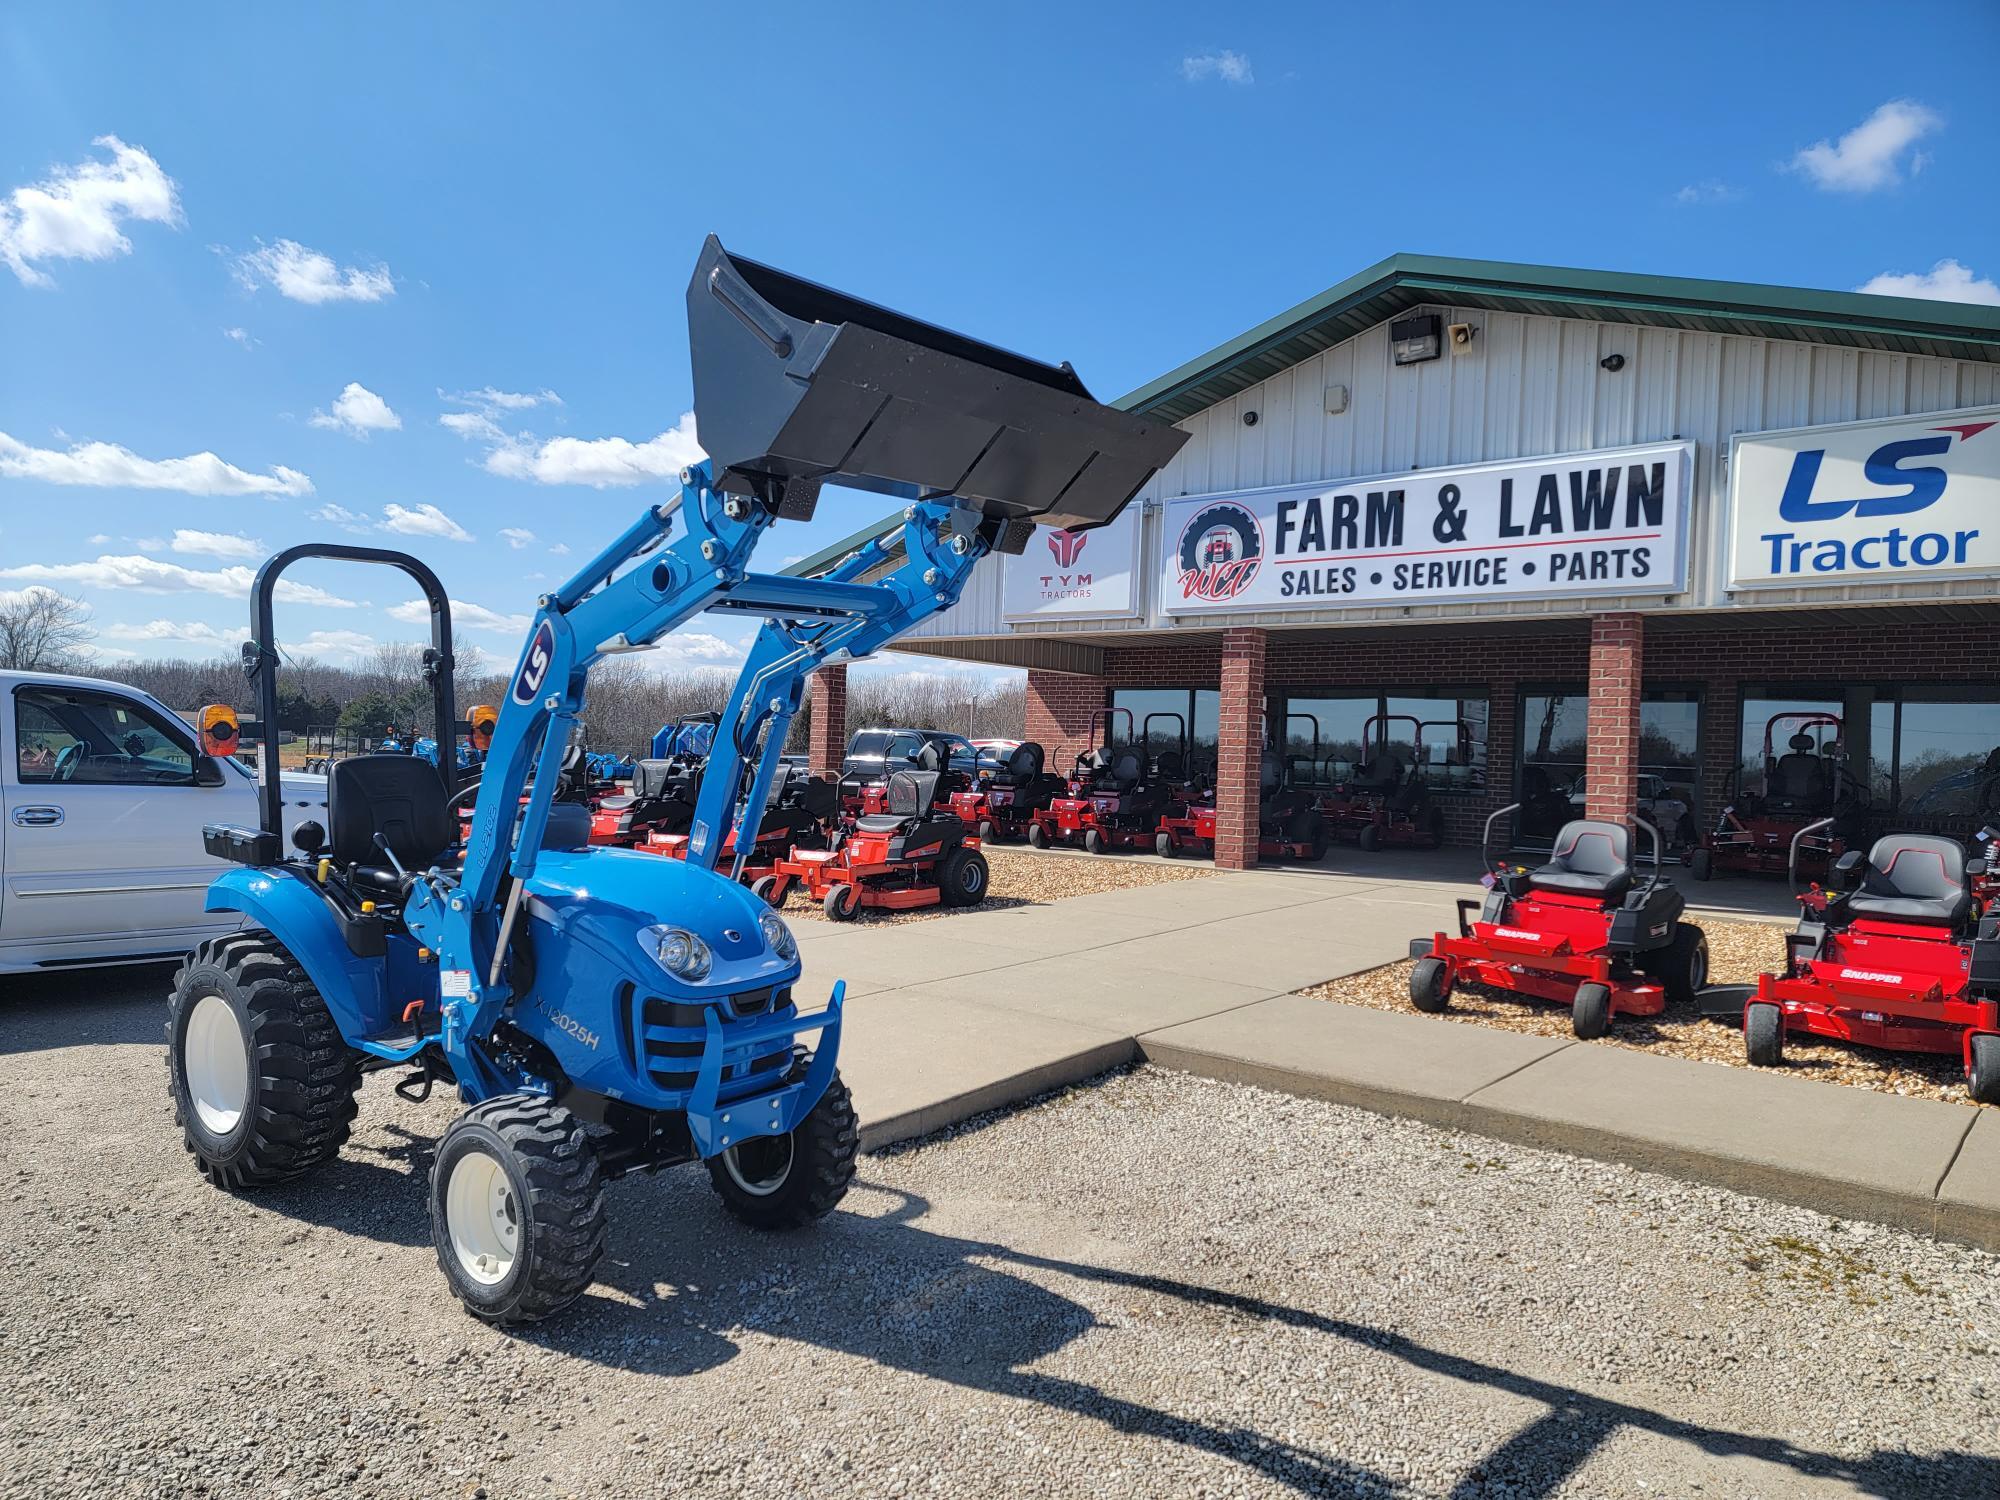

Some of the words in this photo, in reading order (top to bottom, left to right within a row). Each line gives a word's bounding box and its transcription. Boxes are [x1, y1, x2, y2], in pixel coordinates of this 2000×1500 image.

[1779, 435, 1952, 523] LS
[1274, 489, 1405, 555] FARM
[1432, 483, 1468, 544] &
[1499, 462, 1666, 539] LAWN
[1281, 566, 1357, 597] SALES
[1392, 557, 1508, 592] SERVICE
[1548, 547, 1652, 582] PARTS
[1760, 527, 1979, 575] Tractor
[1040, 573, 1092, 587] TYM
[1040, 589, 1092, 600] TRACTORS
[1177, 557, 1262, 599] WCT
[524, 644, 548, 691] LS
[1494, 928, 1541, 942] SNAPPER
[1840, 968, 1903, 984] SNAPPER
